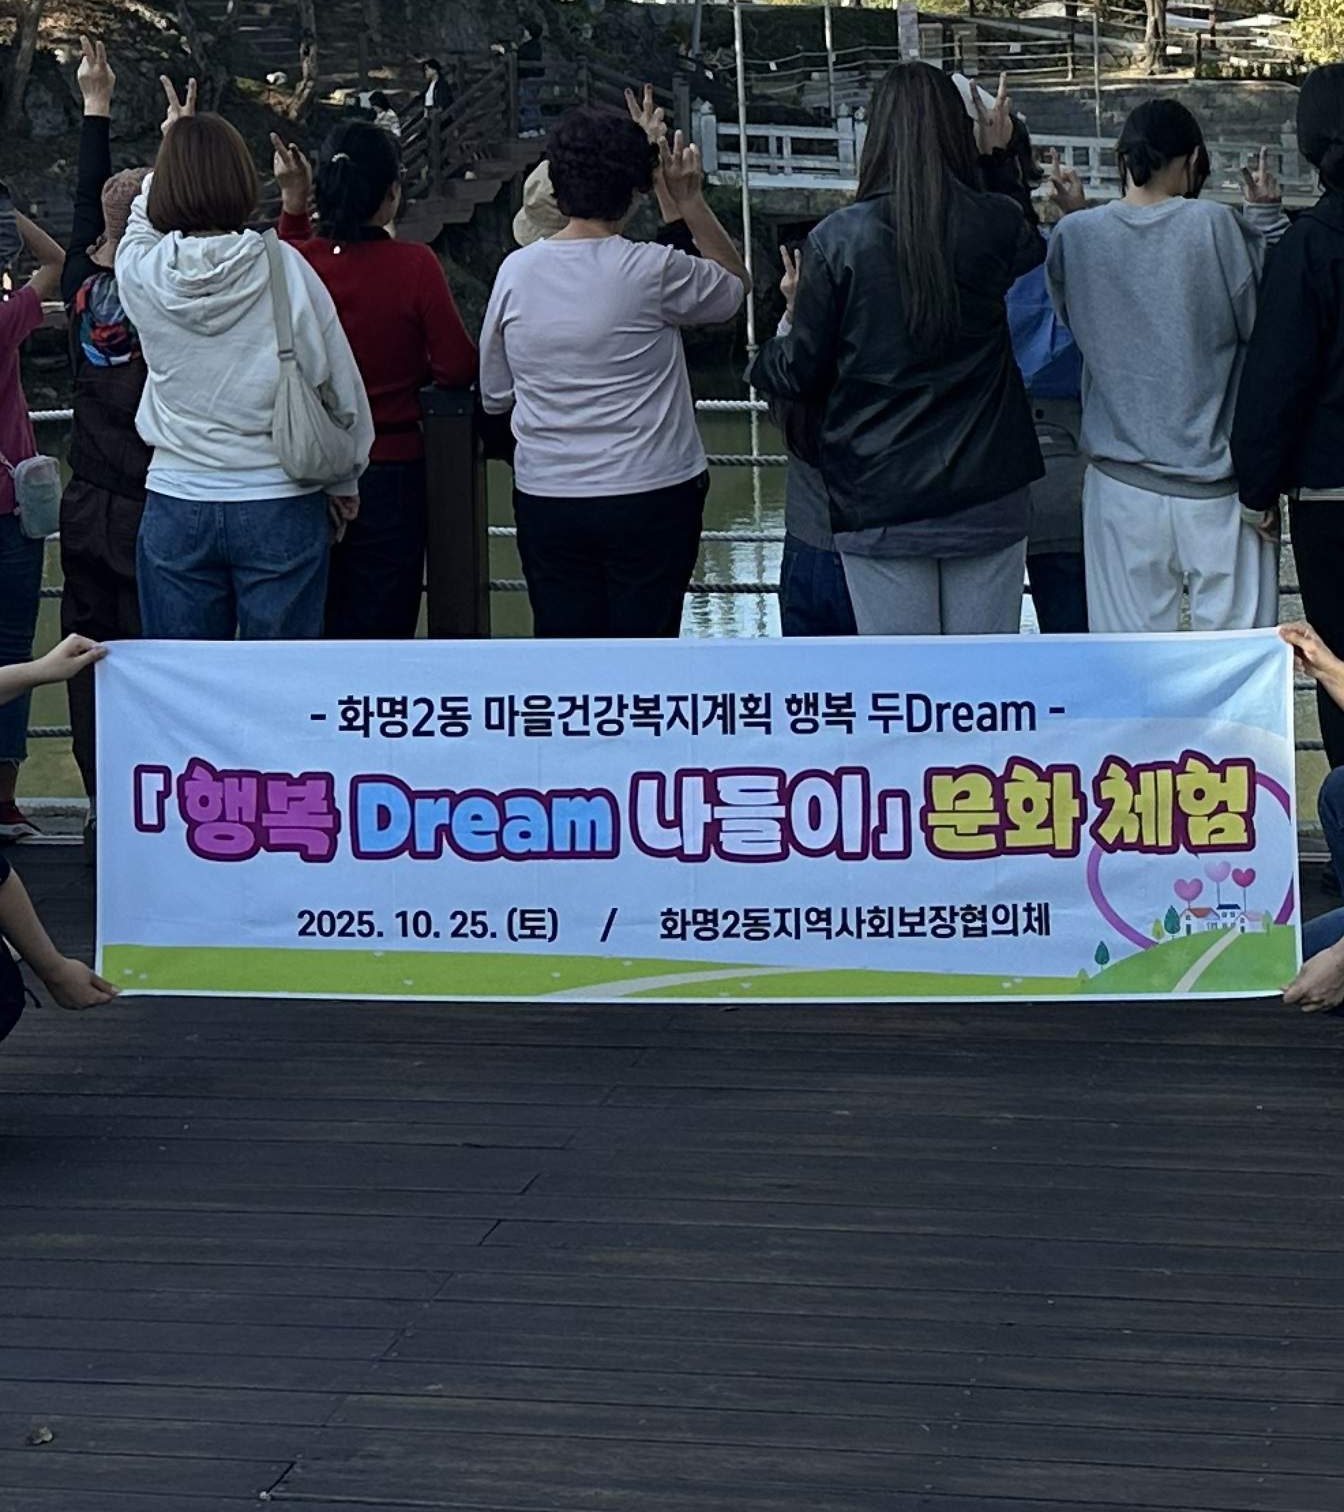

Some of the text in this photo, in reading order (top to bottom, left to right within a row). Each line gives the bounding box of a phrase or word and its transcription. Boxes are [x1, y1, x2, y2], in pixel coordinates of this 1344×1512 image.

[337, 694, 472, 739] 화명2동
[484, 692, 772, 738] 마을건강복지계획
[784, 691, 857, 736] 행복
[868, 691, 1037, 736] 두Dream
[350, 773, 621, 861] Dream
[920, 754, 1088, 860] 문화
[1092, 750, 1257, 855] 체험
[297, 908, 385, 940] 2025.
[394, 909, 441, 941] 10.
[449, 909, 498, 941] 25.
[506, 907, 558, 944] (토)
[659, 901, 1051, 942] 화명2동지역사회보장협의체
